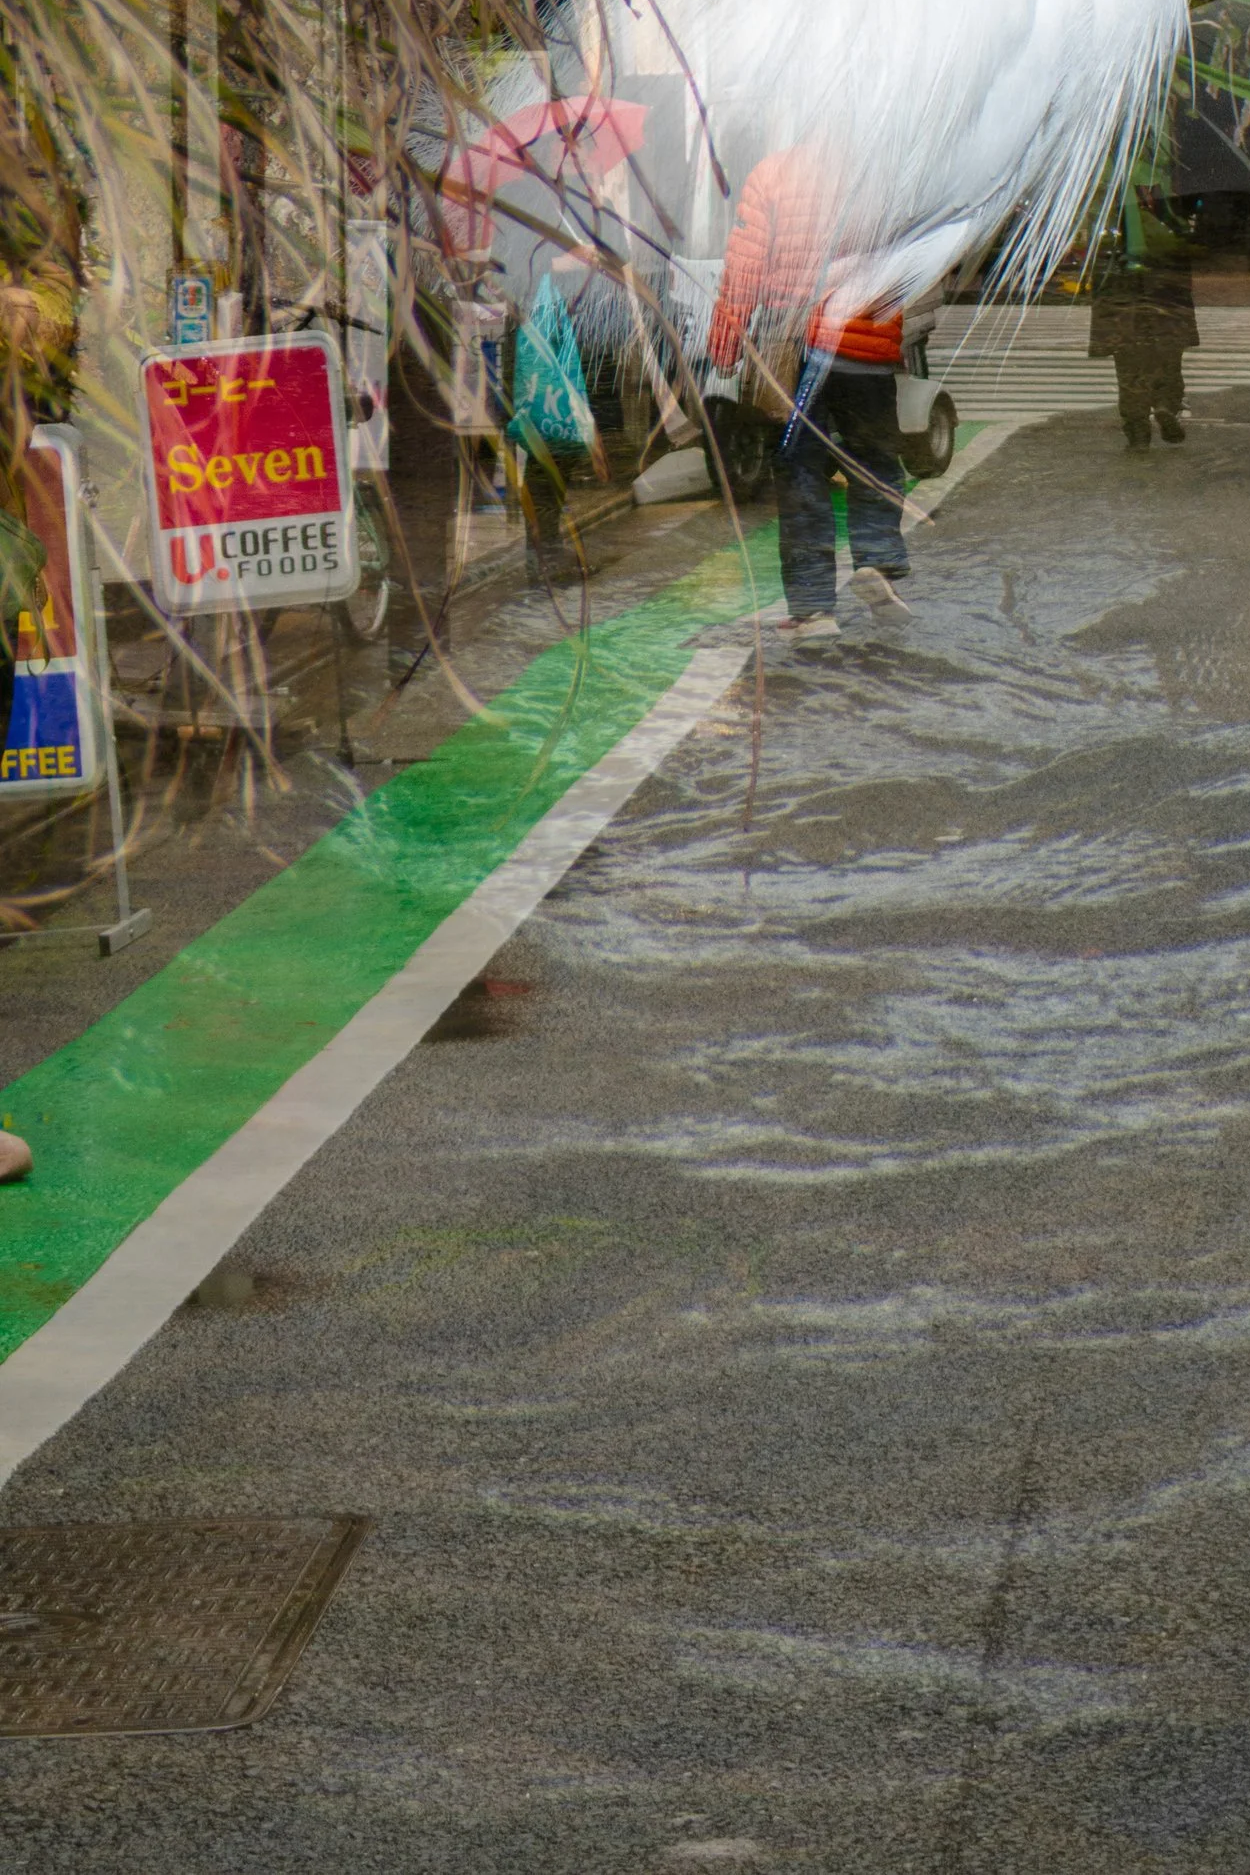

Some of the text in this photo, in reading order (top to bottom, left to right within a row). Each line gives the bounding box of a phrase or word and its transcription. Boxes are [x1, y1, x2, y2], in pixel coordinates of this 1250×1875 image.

[163, 375, 276, 406] コーヒー
[167, 442, 328, 494] Seven
[221, 521, 338, 559] COFFEE
[237, 552, 339, 579] FOODS
